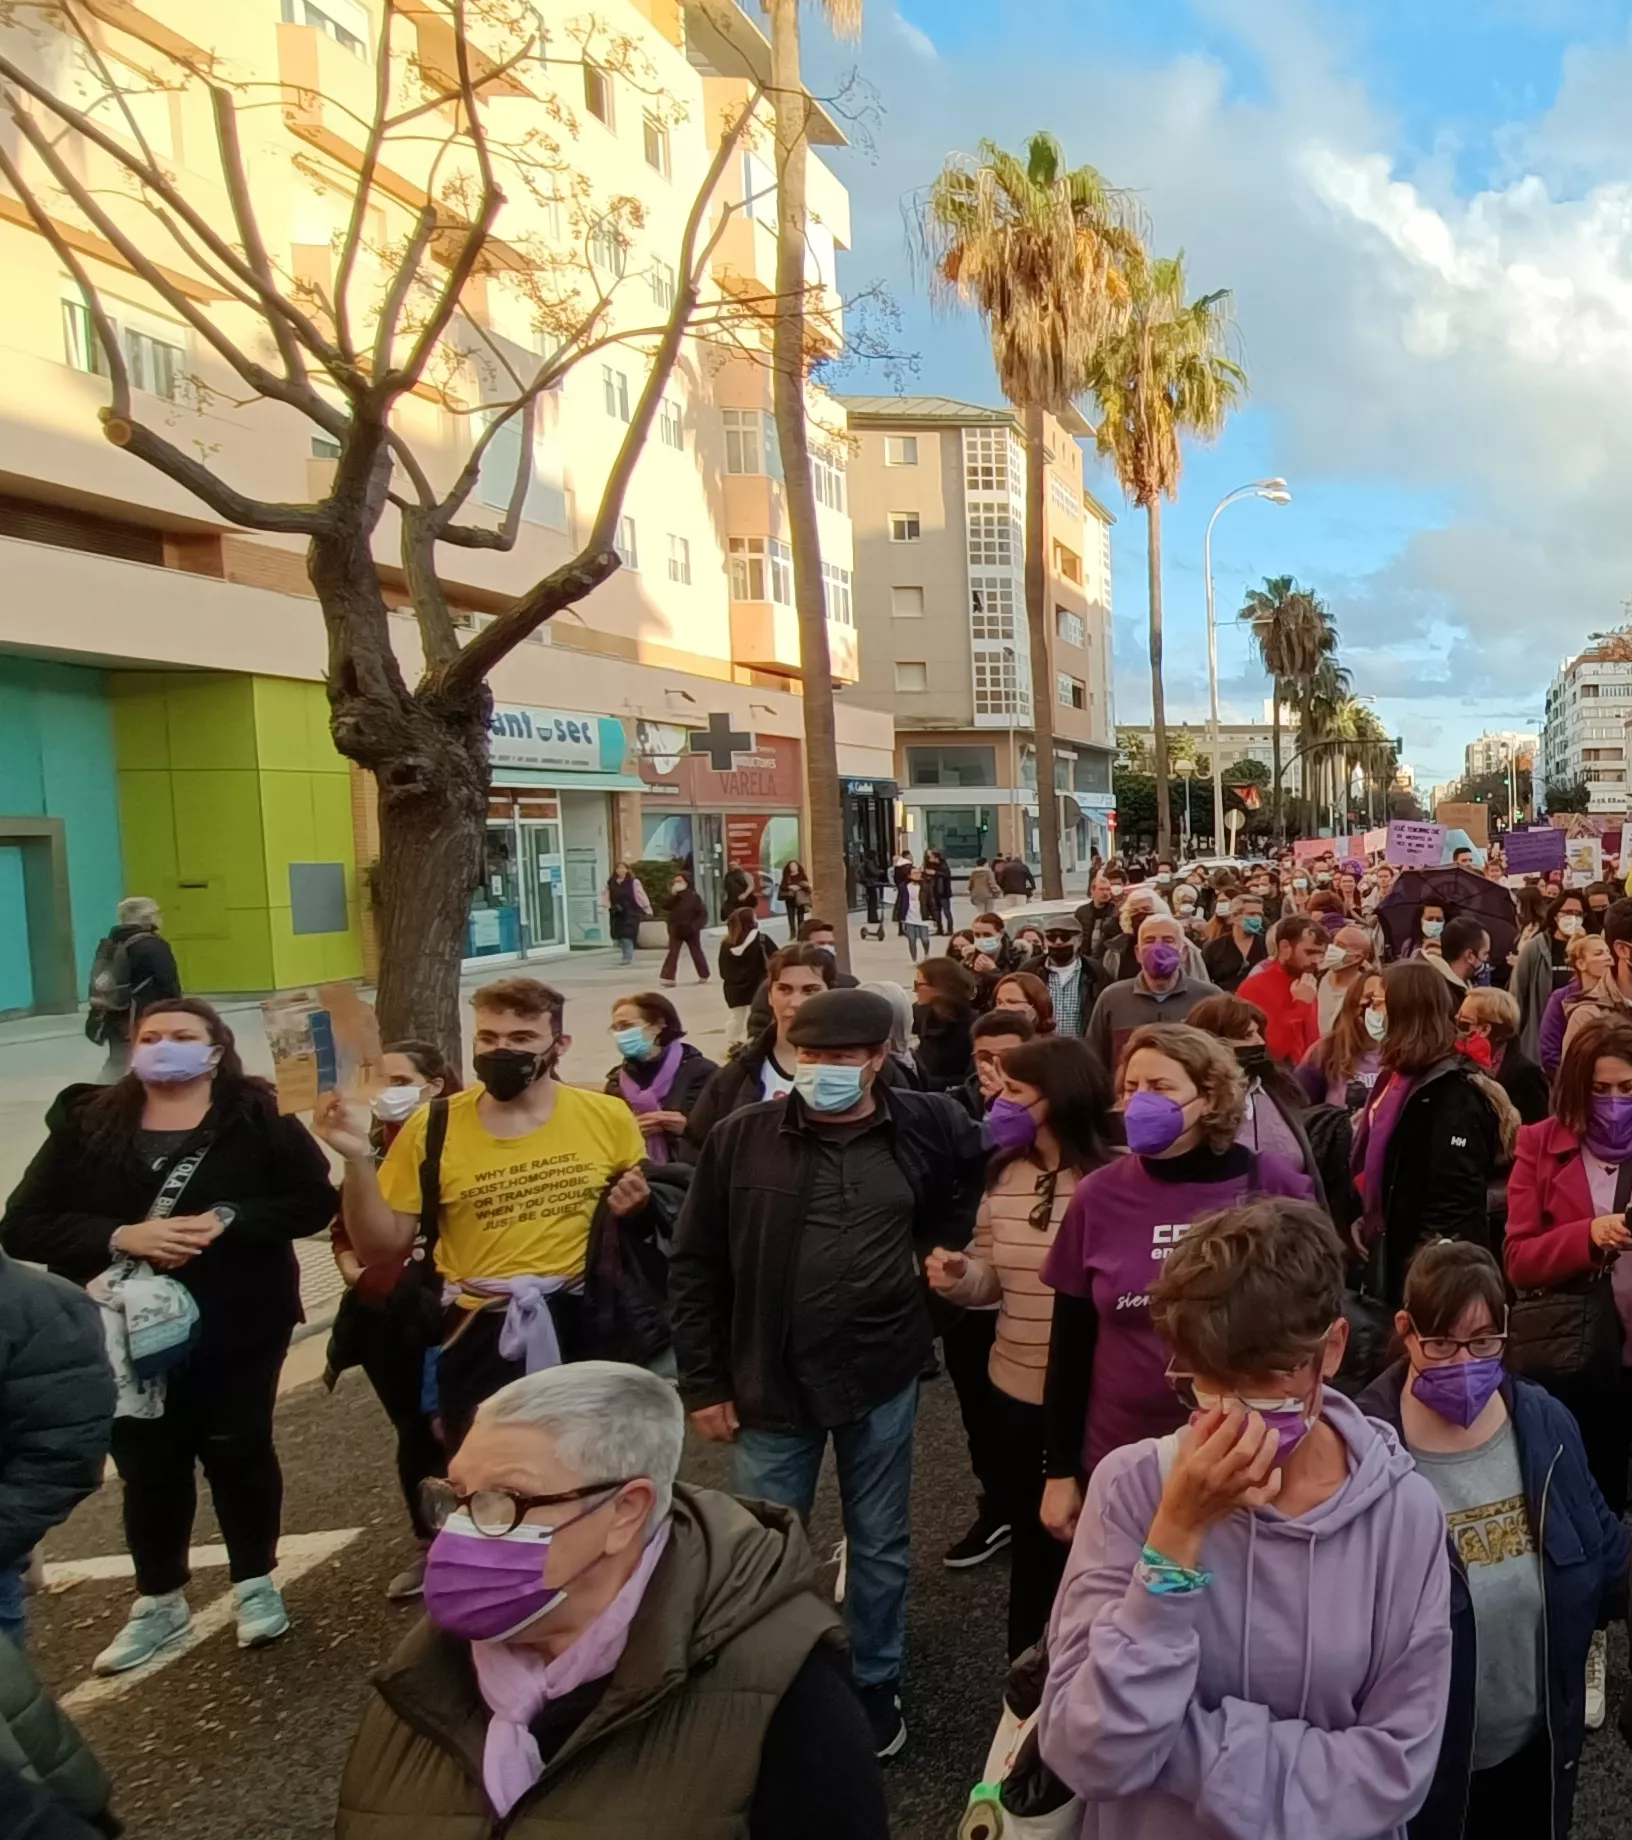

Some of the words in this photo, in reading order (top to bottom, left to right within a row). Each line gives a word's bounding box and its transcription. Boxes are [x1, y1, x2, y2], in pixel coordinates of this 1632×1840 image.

[719, 770, 779, 797] VARELA
[1451, 1136, 1467, 1148] HH
[166, 1156, 202, 1189] LOLA
[474, 1168, 507, 1183] WHY
[509, 1162, 528, 1175] BE
[473, 1197, 493, 1210] OR
[496, 1175, 590, 1202] TRANSPHOBIC
[475, 1204, 514, 1220] WHEN
[517, 1196, 545, 1211] YOU
[482, 1216, 516, 1232] JUST
[518, 1210, 537, 1223] BE
